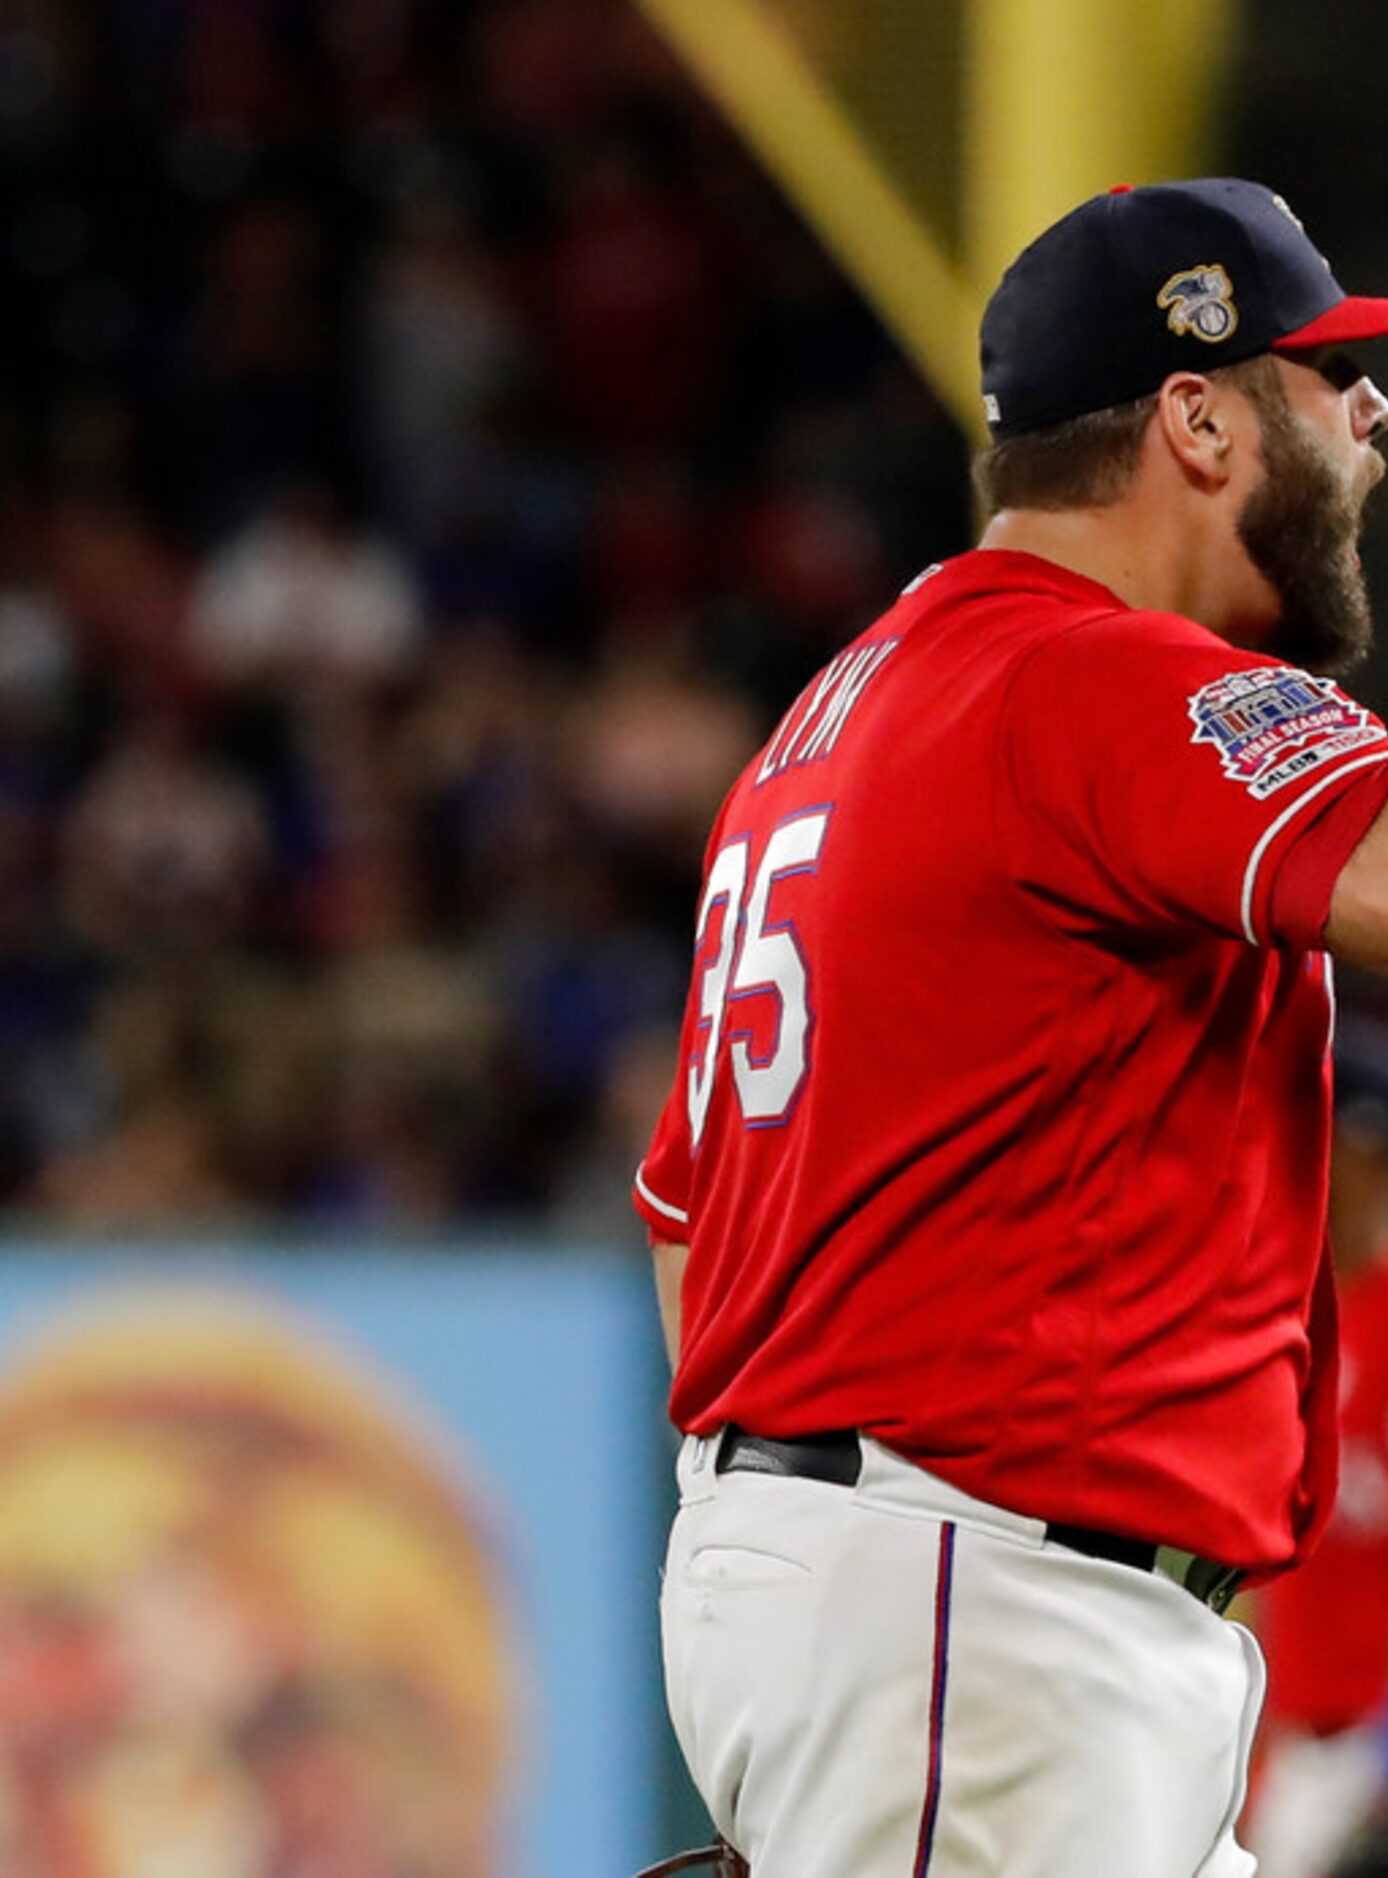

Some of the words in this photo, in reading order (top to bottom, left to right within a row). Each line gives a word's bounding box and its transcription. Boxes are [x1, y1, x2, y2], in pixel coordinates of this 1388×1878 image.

[1238, 730, 1282, 764] FINAL
[1280, 708, 1344, 738] SEASON
[688, 803, 834, 1157] 35
